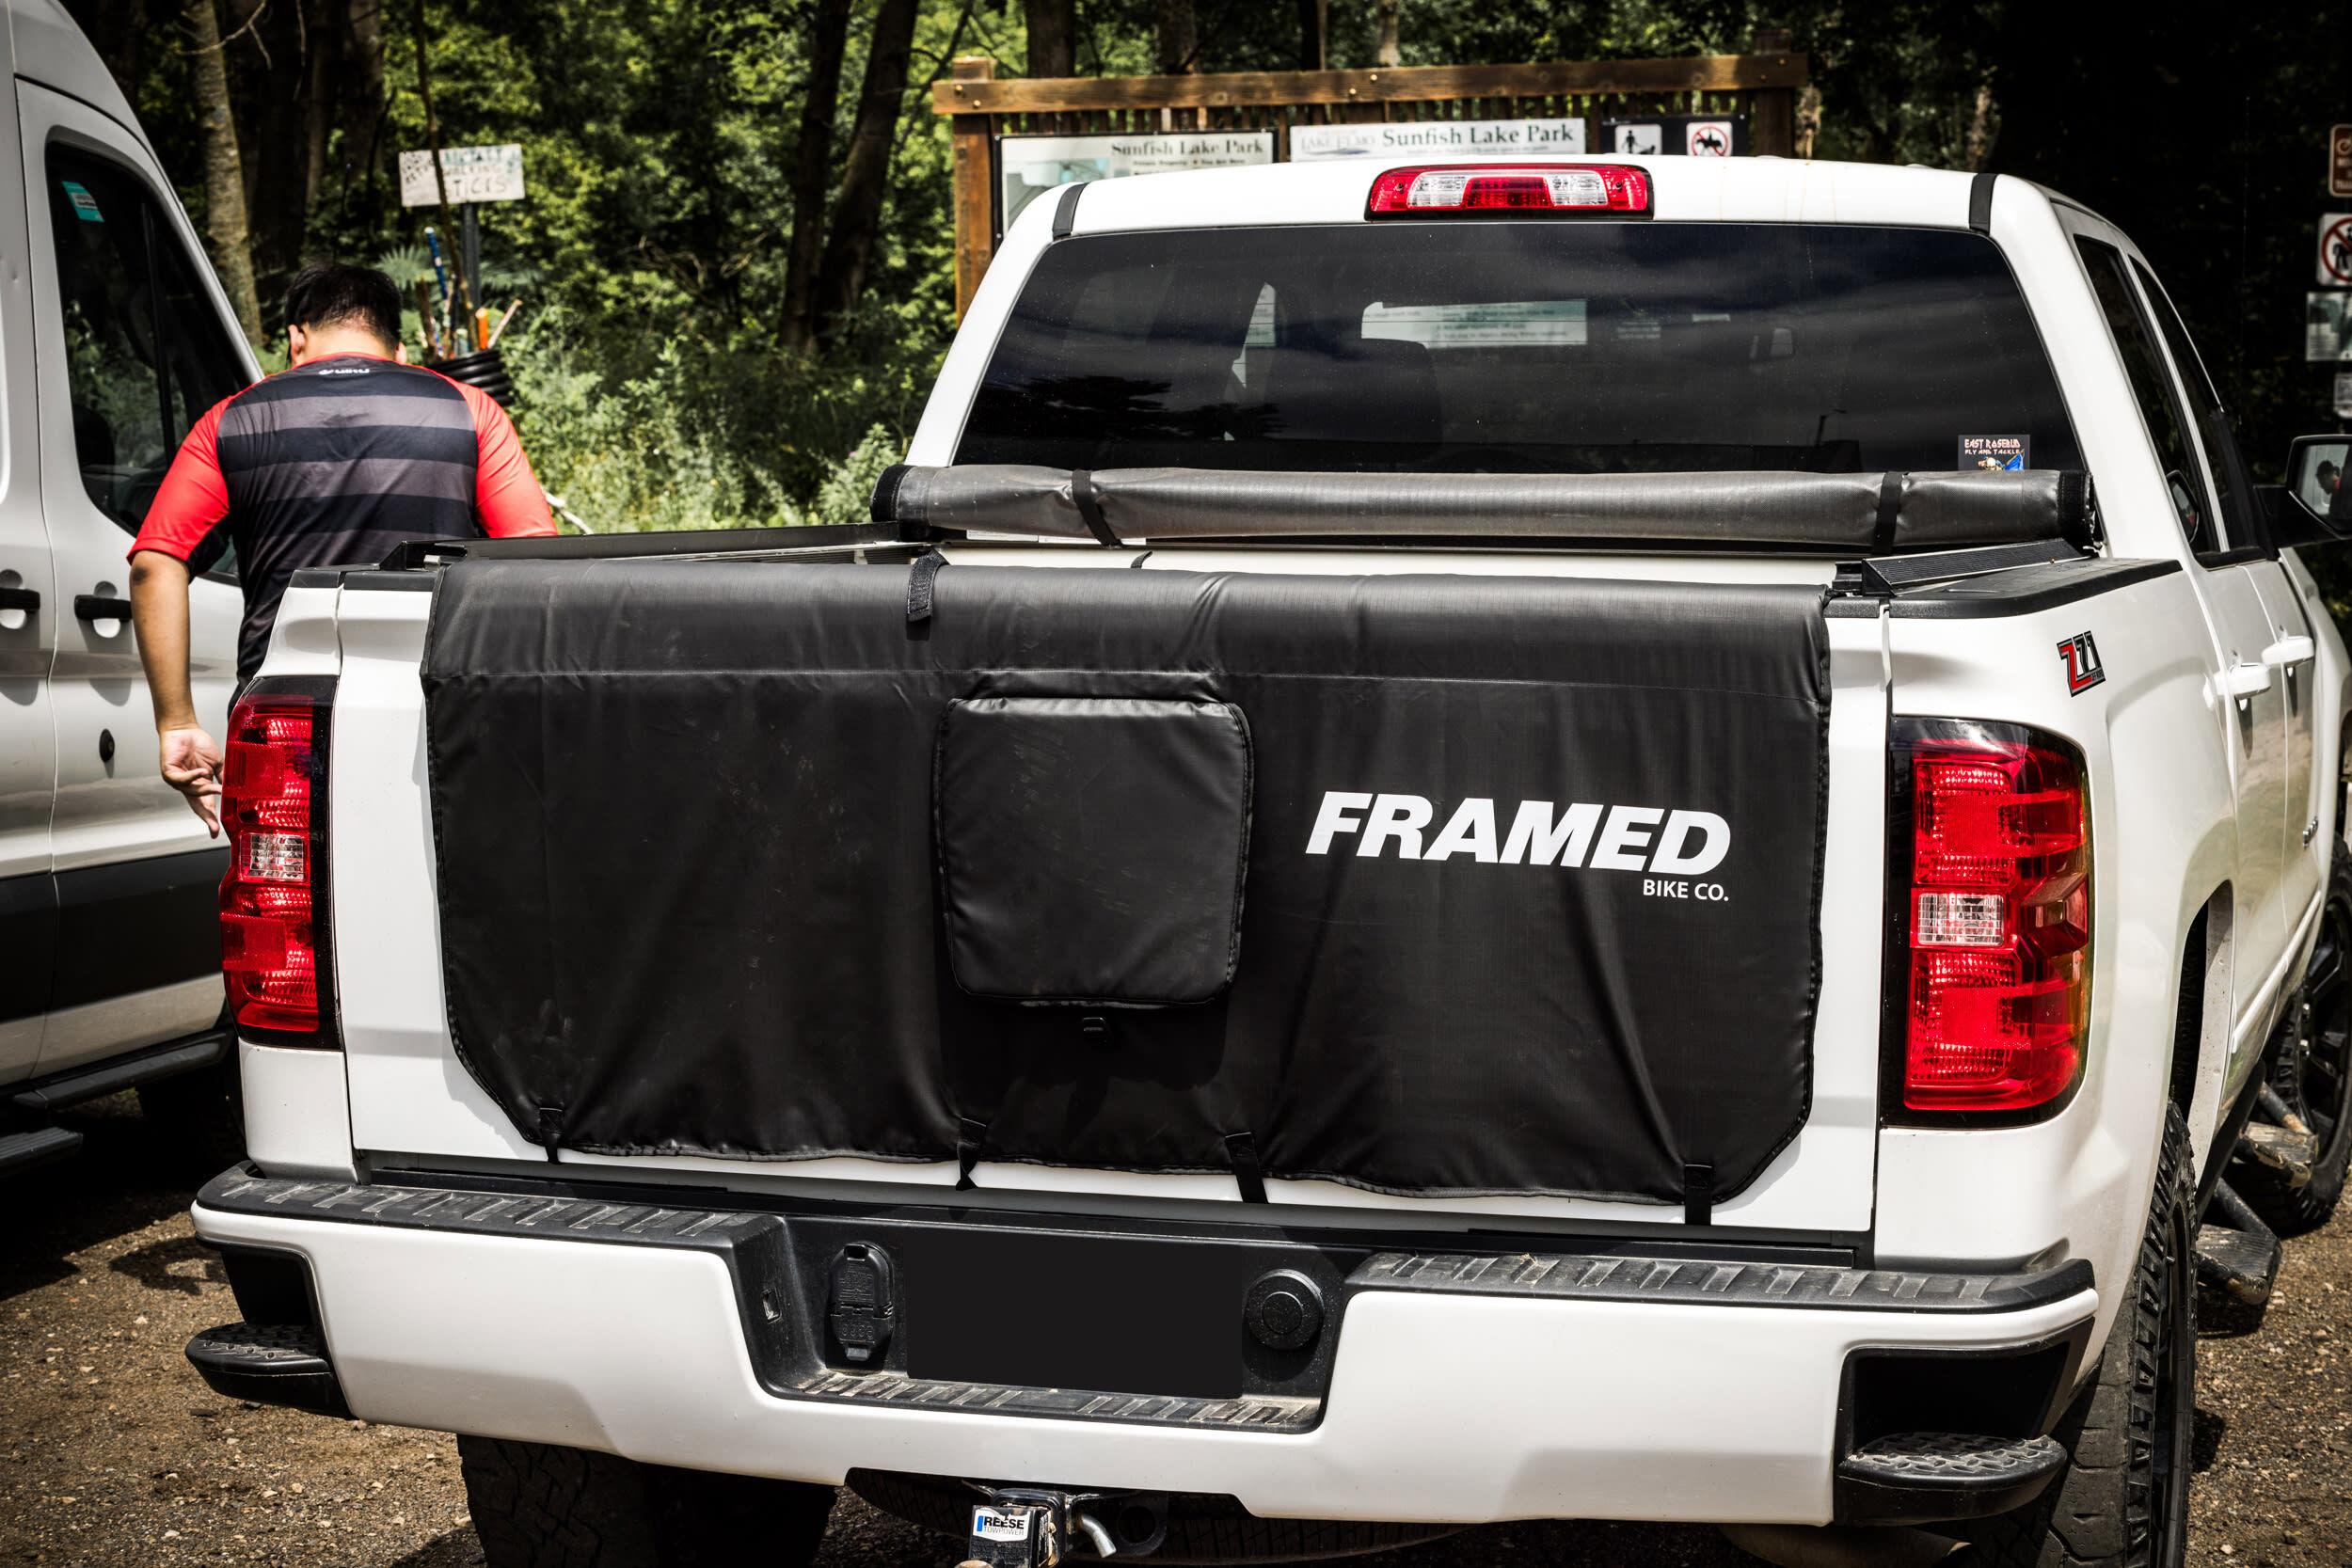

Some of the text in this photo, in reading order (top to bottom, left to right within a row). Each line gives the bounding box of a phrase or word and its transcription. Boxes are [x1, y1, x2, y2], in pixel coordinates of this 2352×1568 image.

[1383, 123, 1573, 147] Sunfish Lake Park
[1111, 138, 1264, 156] Sunfish Lake Park
[1964, 438, 2021, 449] EAST ROSEBUD
[2057, 630, 2106, 697] Z71
[1305, 790, 1731, 876] FRAMED
[1643, 879, 1729, 902] BIKE CO.
[984, 1516, 1025, 1529] REESE
[984, 1526, 1025, 1536] TOWPOWER
